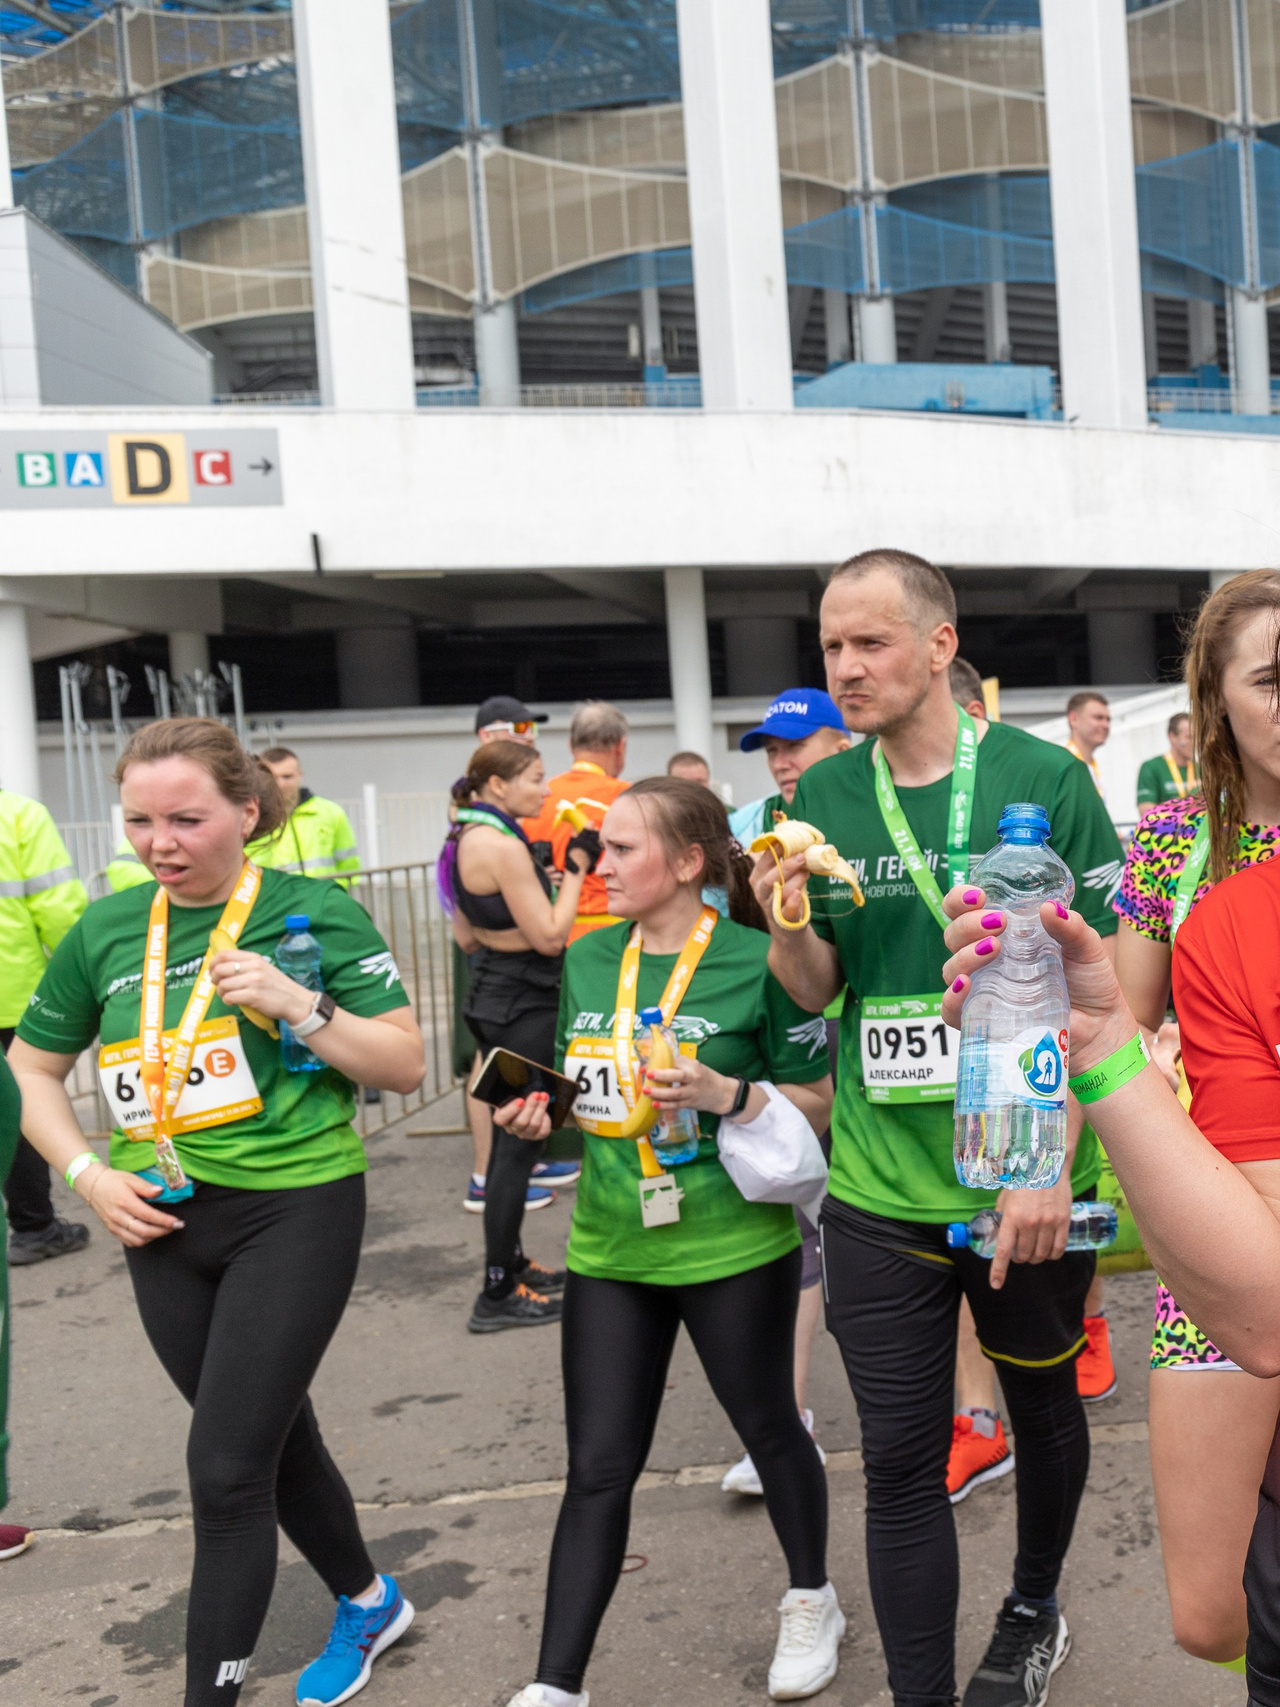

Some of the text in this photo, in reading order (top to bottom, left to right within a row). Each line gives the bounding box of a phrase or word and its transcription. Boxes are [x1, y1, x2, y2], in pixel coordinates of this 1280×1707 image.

[22, 441, 228, 496] B A D C
[765, 700, 808, 722] САТОМ
[868, 1023, 949, 1060] 0951
[210, 1051, 231, 1075] E
[869, 1067, 934, 1080] АЛЕКСАНДР
[122, 1107, 152, 1123] ИРИН
[576, 1103, 611, 1116] ИРИНА
